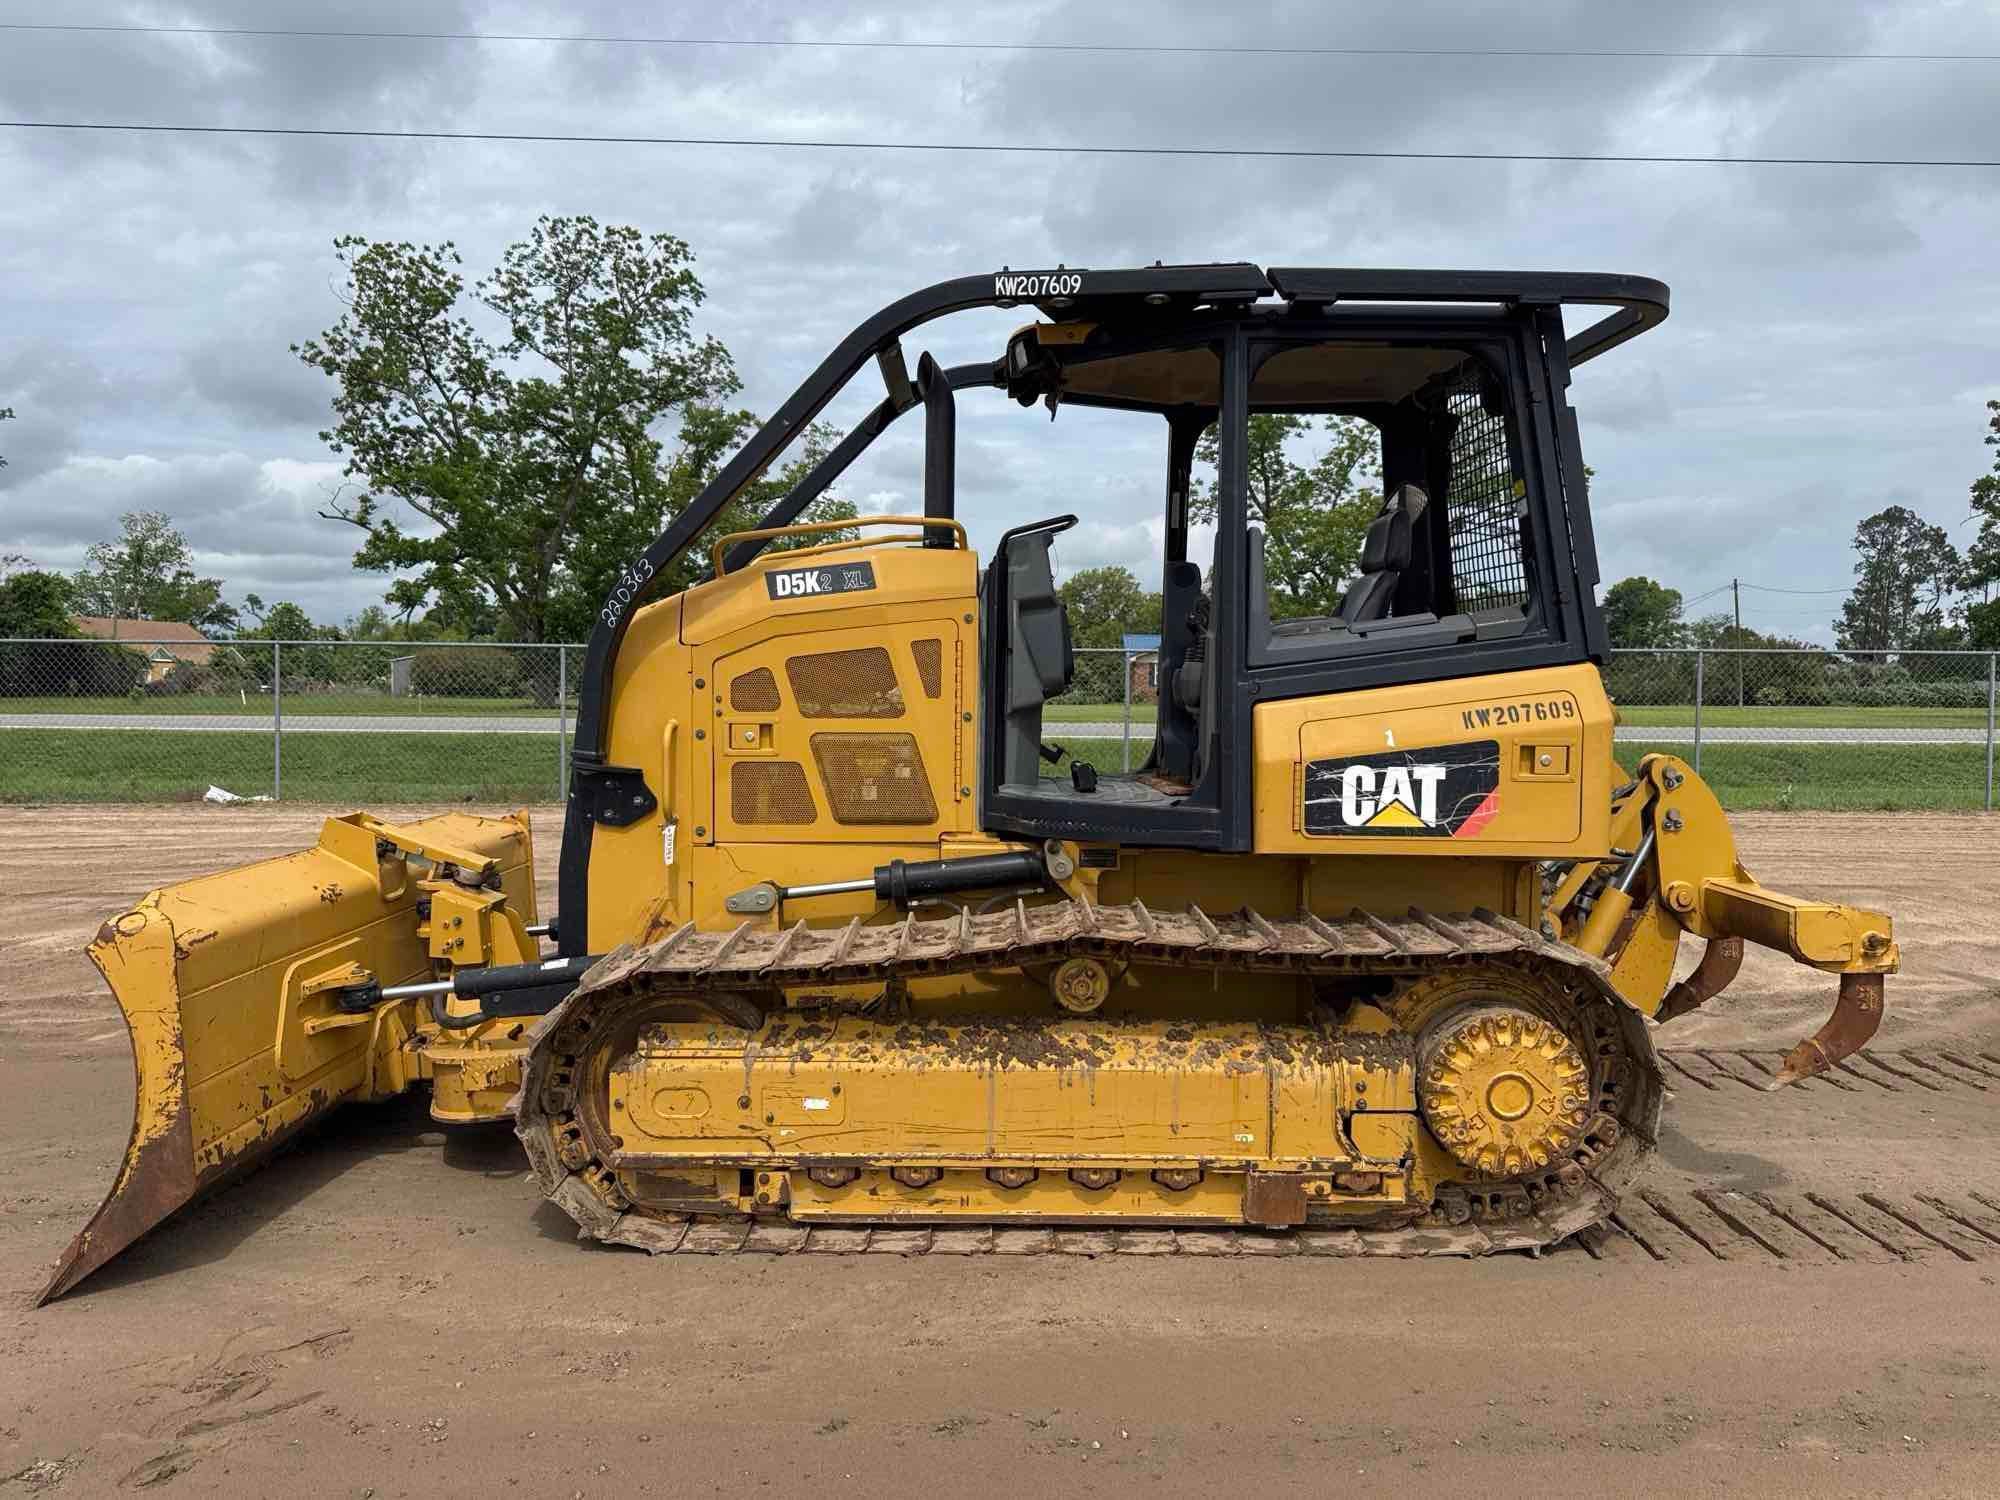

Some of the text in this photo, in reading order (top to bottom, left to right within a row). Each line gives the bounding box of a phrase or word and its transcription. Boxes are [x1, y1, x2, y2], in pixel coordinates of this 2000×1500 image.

[995, 274, 1081, 296] KW207609
[601, 558, 654, 628] 220363
[843, 569, 868, 590] XL
[1462, 700, 1575, 729] KW207609
[1341, 764, 1446, 828] CAT
